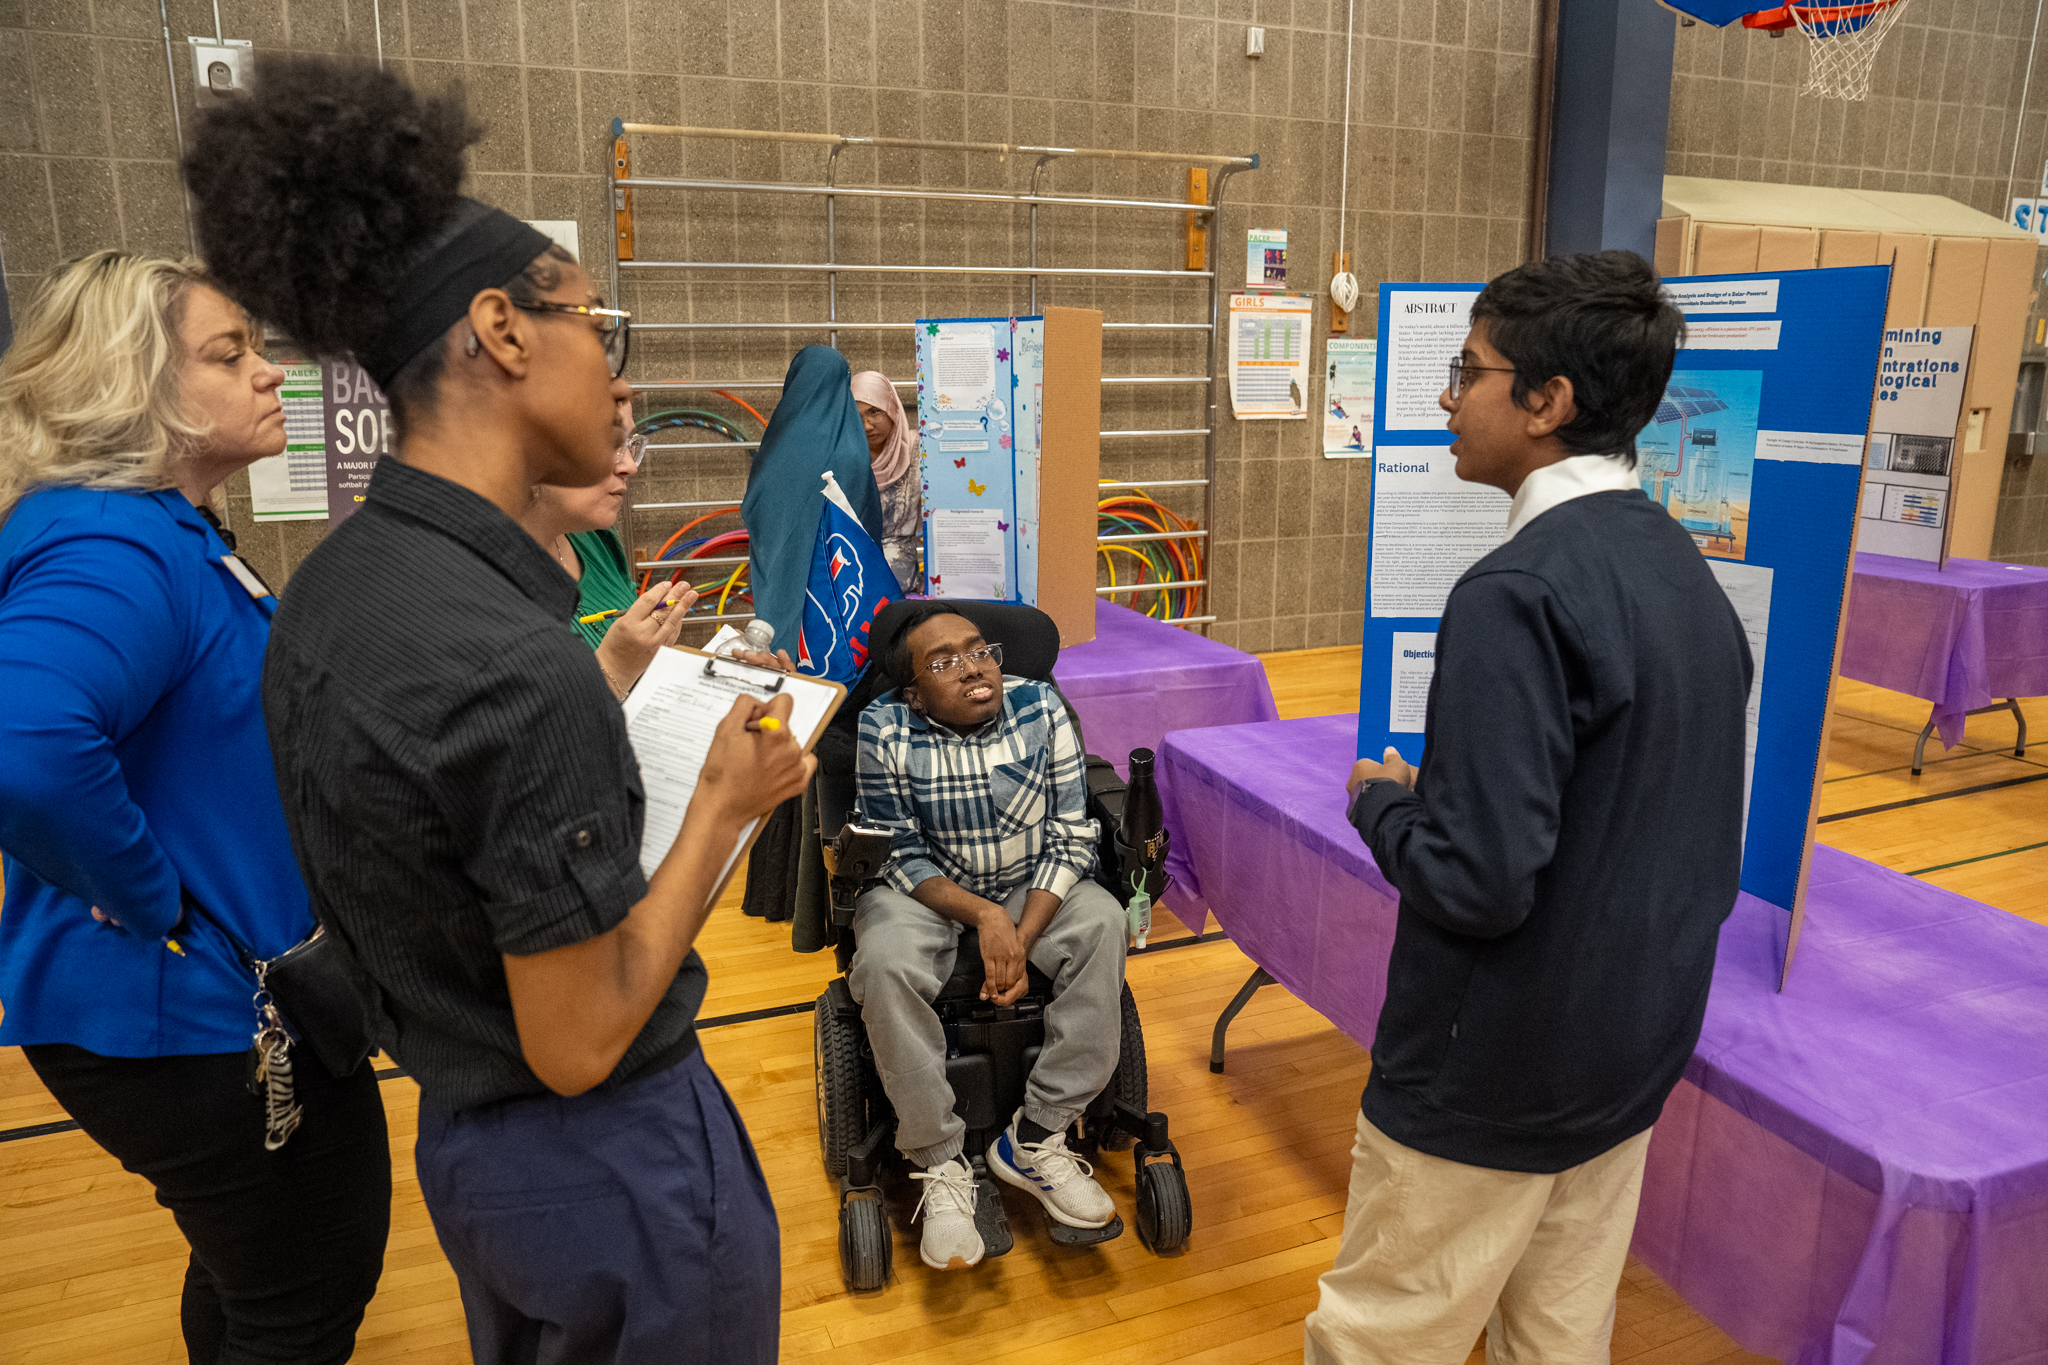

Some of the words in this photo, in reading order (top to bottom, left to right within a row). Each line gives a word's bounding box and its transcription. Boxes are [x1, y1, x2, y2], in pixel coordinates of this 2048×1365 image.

[1235, 297, 1265, 307] GIRLS
[1404, 303, 1457, 313] ABSTRACT
[1885, 328, 1942, 345] mining
[1329, 342, 1376, 350] COMPONENTS
[1884, 347, 1893, 357] n
[1883, 358, 1959, 373] ntrations
[1880, 373, 1937, 389] logical
[1877, 390, 1898, 402] es
[335, 409, 395, 454] SOF
[1378, 462, 1430, 473] Rational
[1403, 649, 1435, 660] Objectiv
